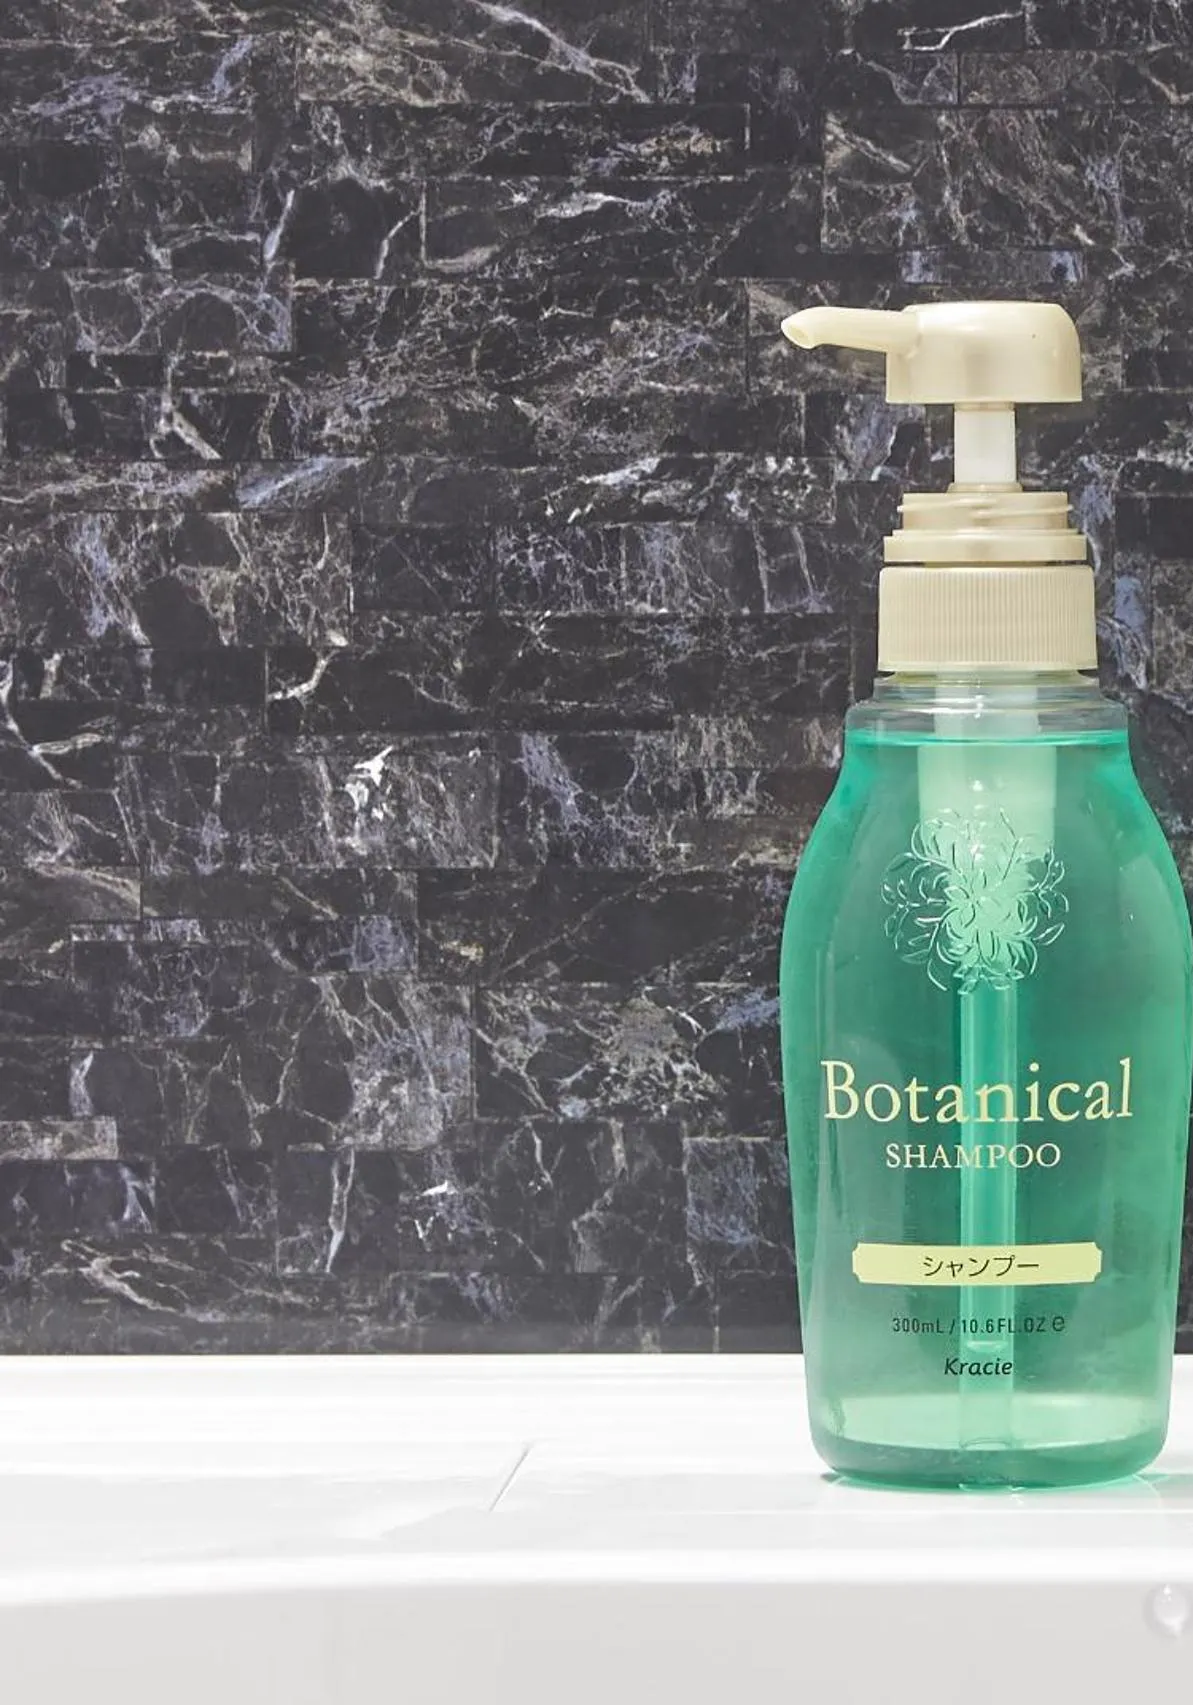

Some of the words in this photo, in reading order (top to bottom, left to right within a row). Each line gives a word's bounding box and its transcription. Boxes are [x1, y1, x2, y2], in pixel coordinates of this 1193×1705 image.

[820, 1057, 1134, 1124] Botanical
[885, 1142, 1062, 1169] SHAMPOO
[922, 1254, 1040, 1278] シャンプー
[892, 1317, 944, 1335] 300mL
[944, 1357, 1013, 1376] Kracie
